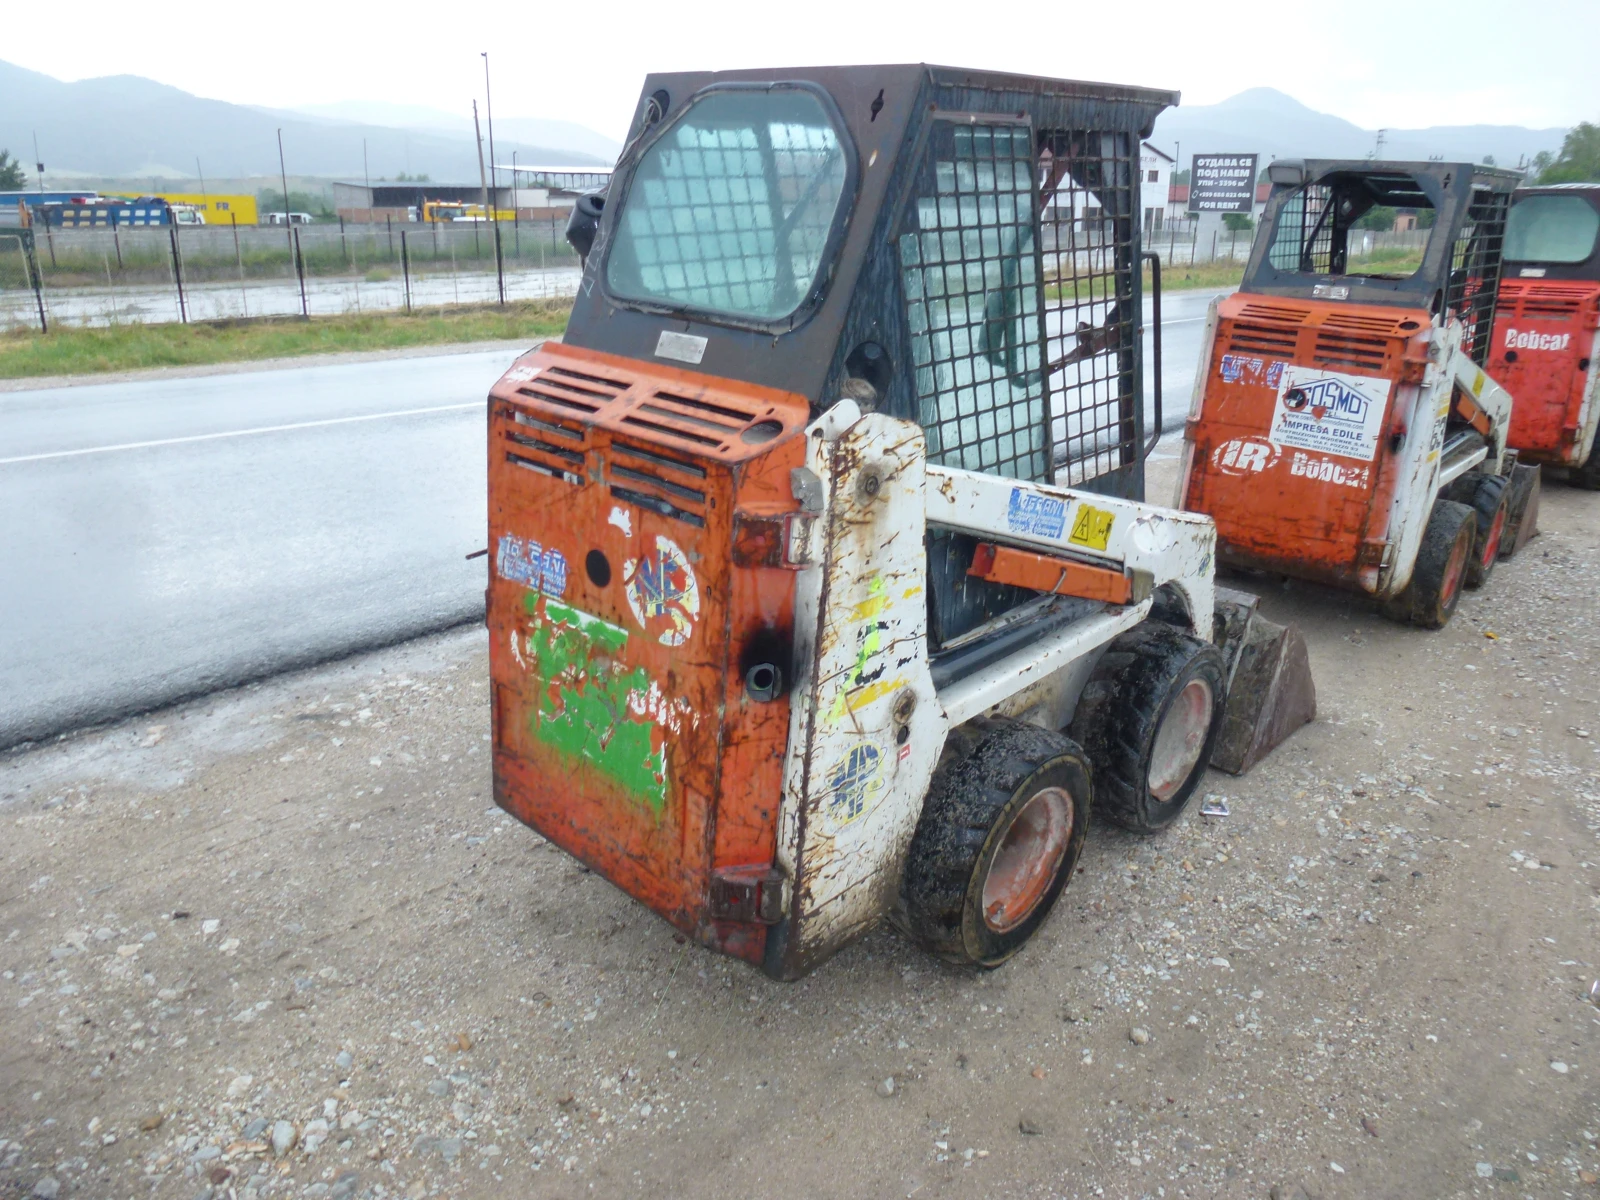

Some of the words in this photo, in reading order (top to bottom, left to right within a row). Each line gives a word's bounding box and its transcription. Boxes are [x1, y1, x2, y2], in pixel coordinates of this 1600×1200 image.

[1197, 158, 1238, 168] ОТДАВА
[1239, 158, 1252, 167] СЕ
[1197, 169, 1219, 178] ПОД
[1220, 169, 1250, 177] НАЕМ
[1199, 201, 1216, 209] FOR
[1505, 328, 1570, 351] Bobcat
[1283, 420, 1329, 435] IMPRESA
[1332, 429, 1364, 441] EDILE
